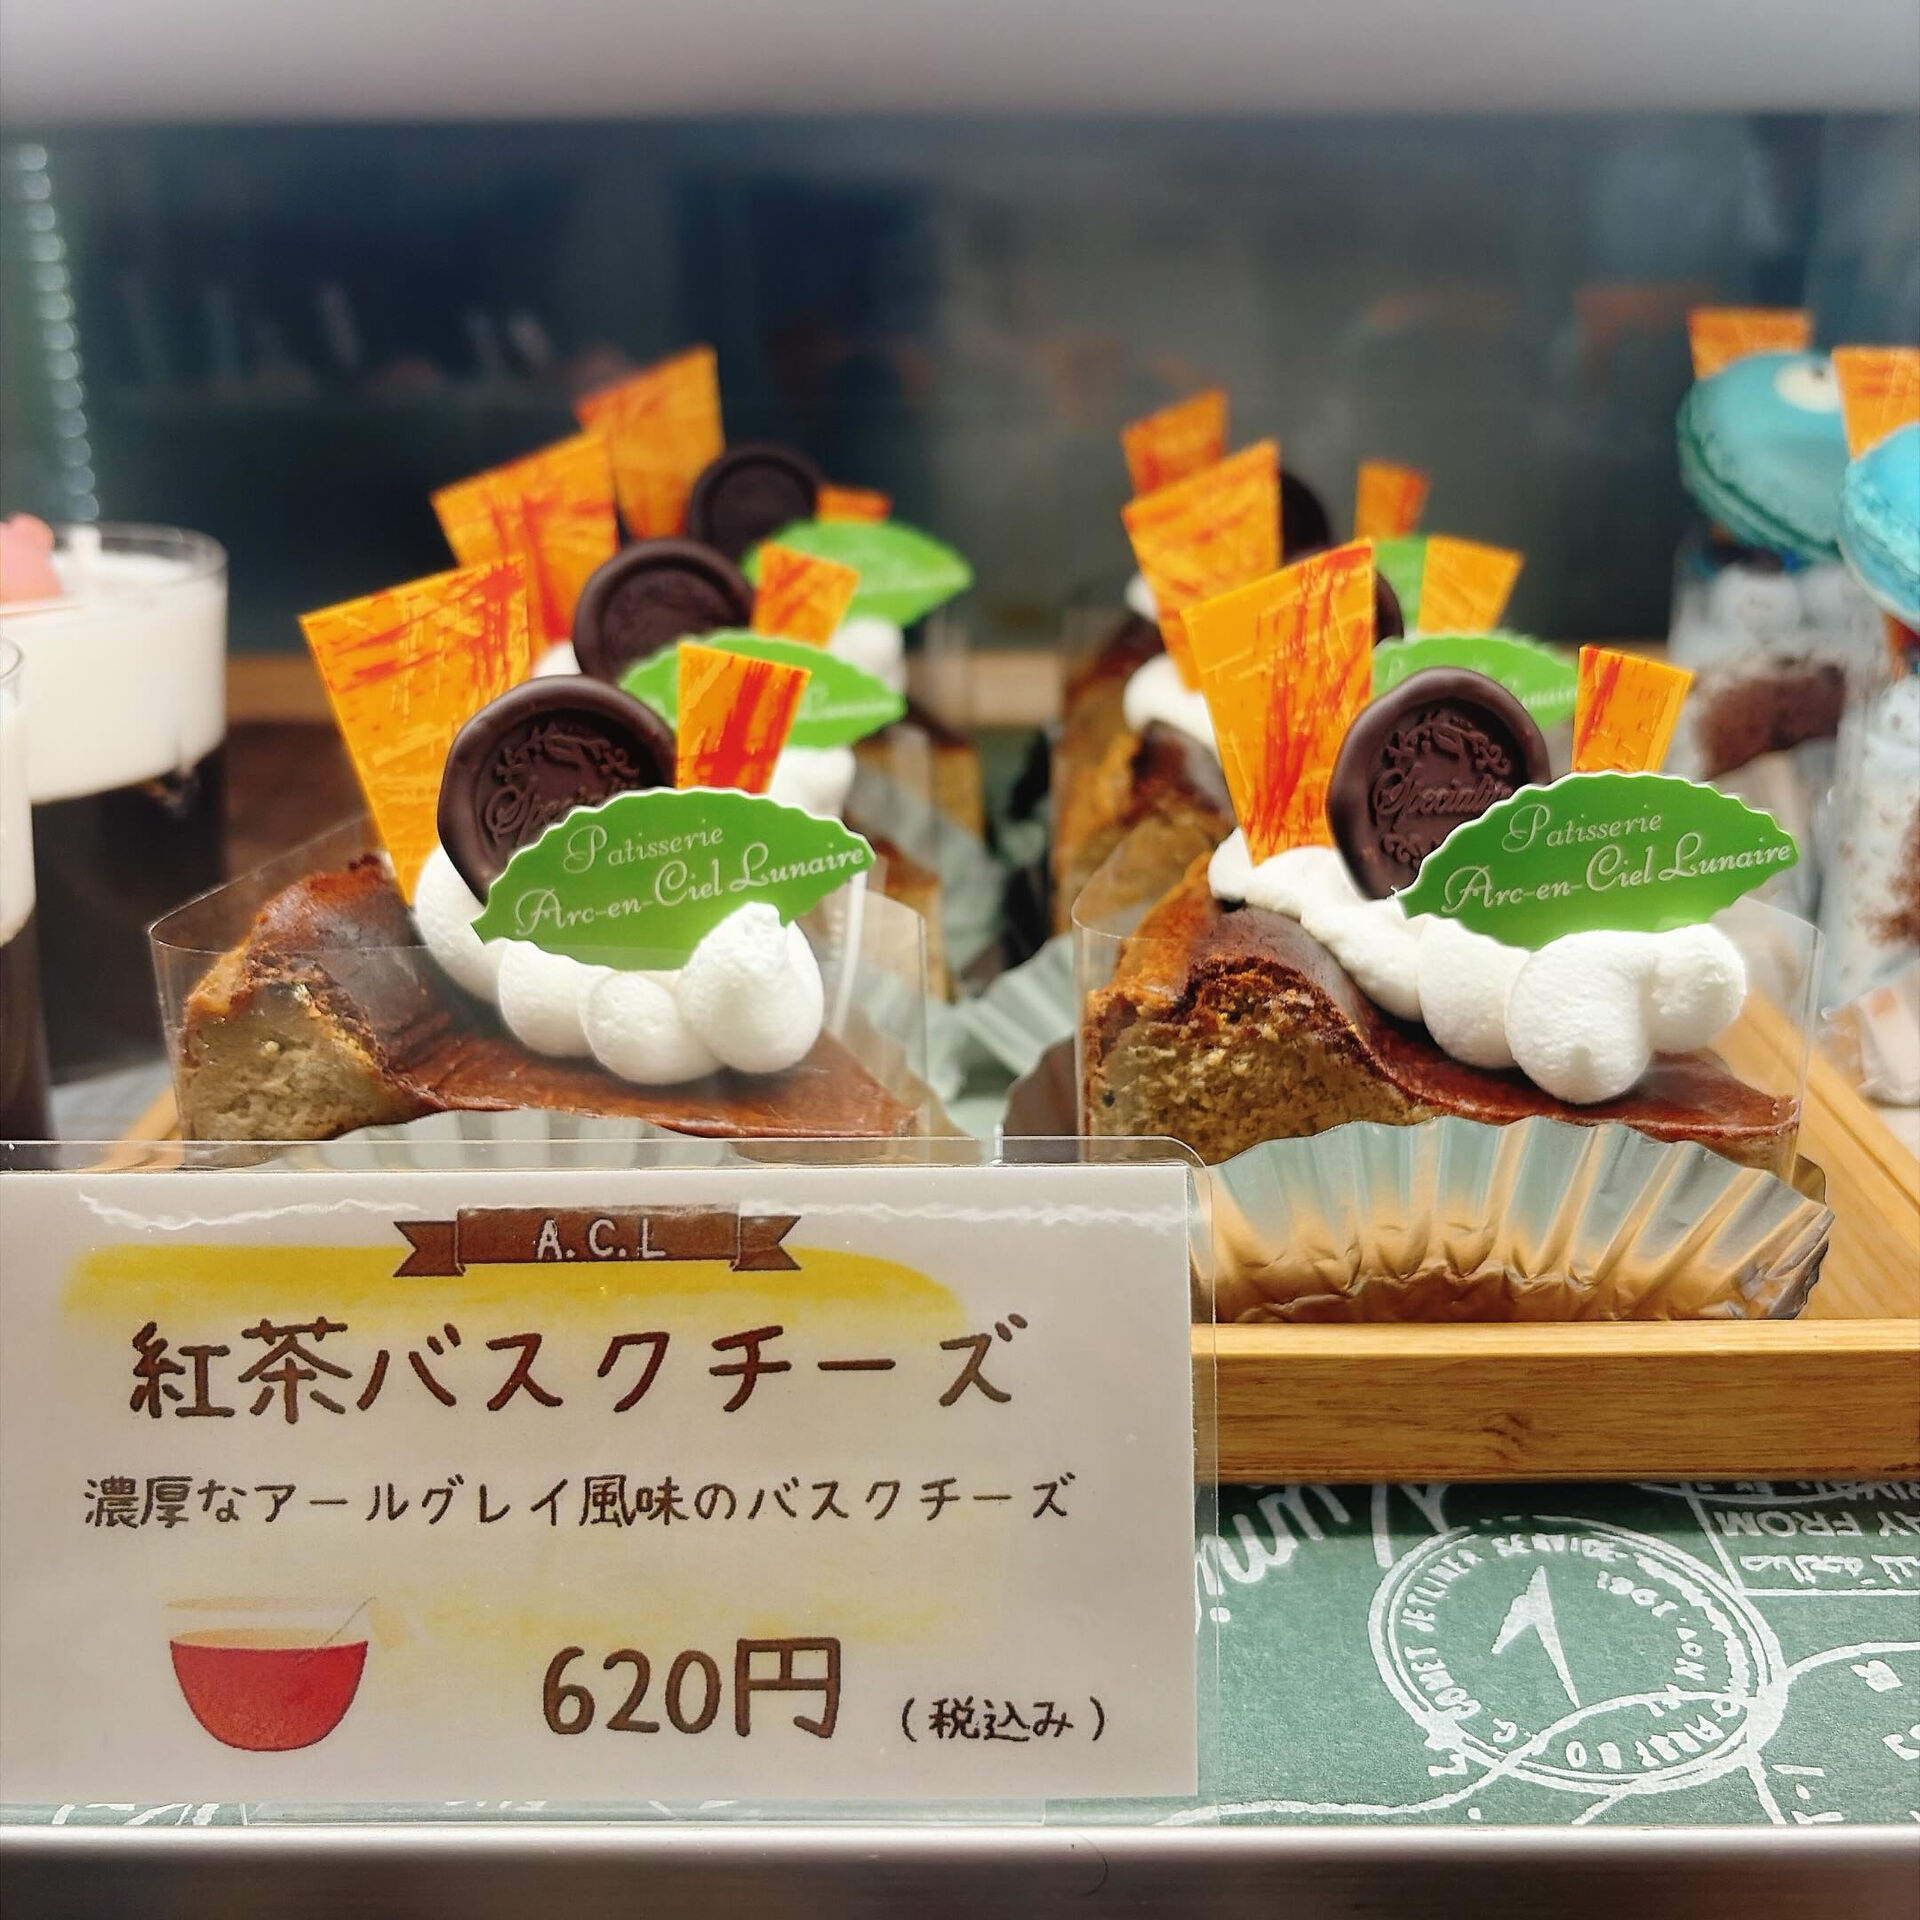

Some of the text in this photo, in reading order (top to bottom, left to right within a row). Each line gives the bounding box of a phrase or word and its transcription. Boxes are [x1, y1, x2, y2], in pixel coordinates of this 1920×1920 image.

[563, 819, 724, 875] Patisserie
[1502, 803, 1662, 853] Patisserie
[515, 842, 865, 937] Arc-en-Ciel Lunaire
[1440, 831, 1793, 914] Arc-en-Ciel Lunaire
[536, 1217, 667, 1260] A.C.L
[130, 1314, 1029, 1425] 紅茶バスクチーズ
[85, 1471, 1076, 1530] 濃厚なアールグレイ風味のバスクチーズ
[1714, 1510, 1863, 1537] FROM
[541, 1636, 842, 1740] 620円
